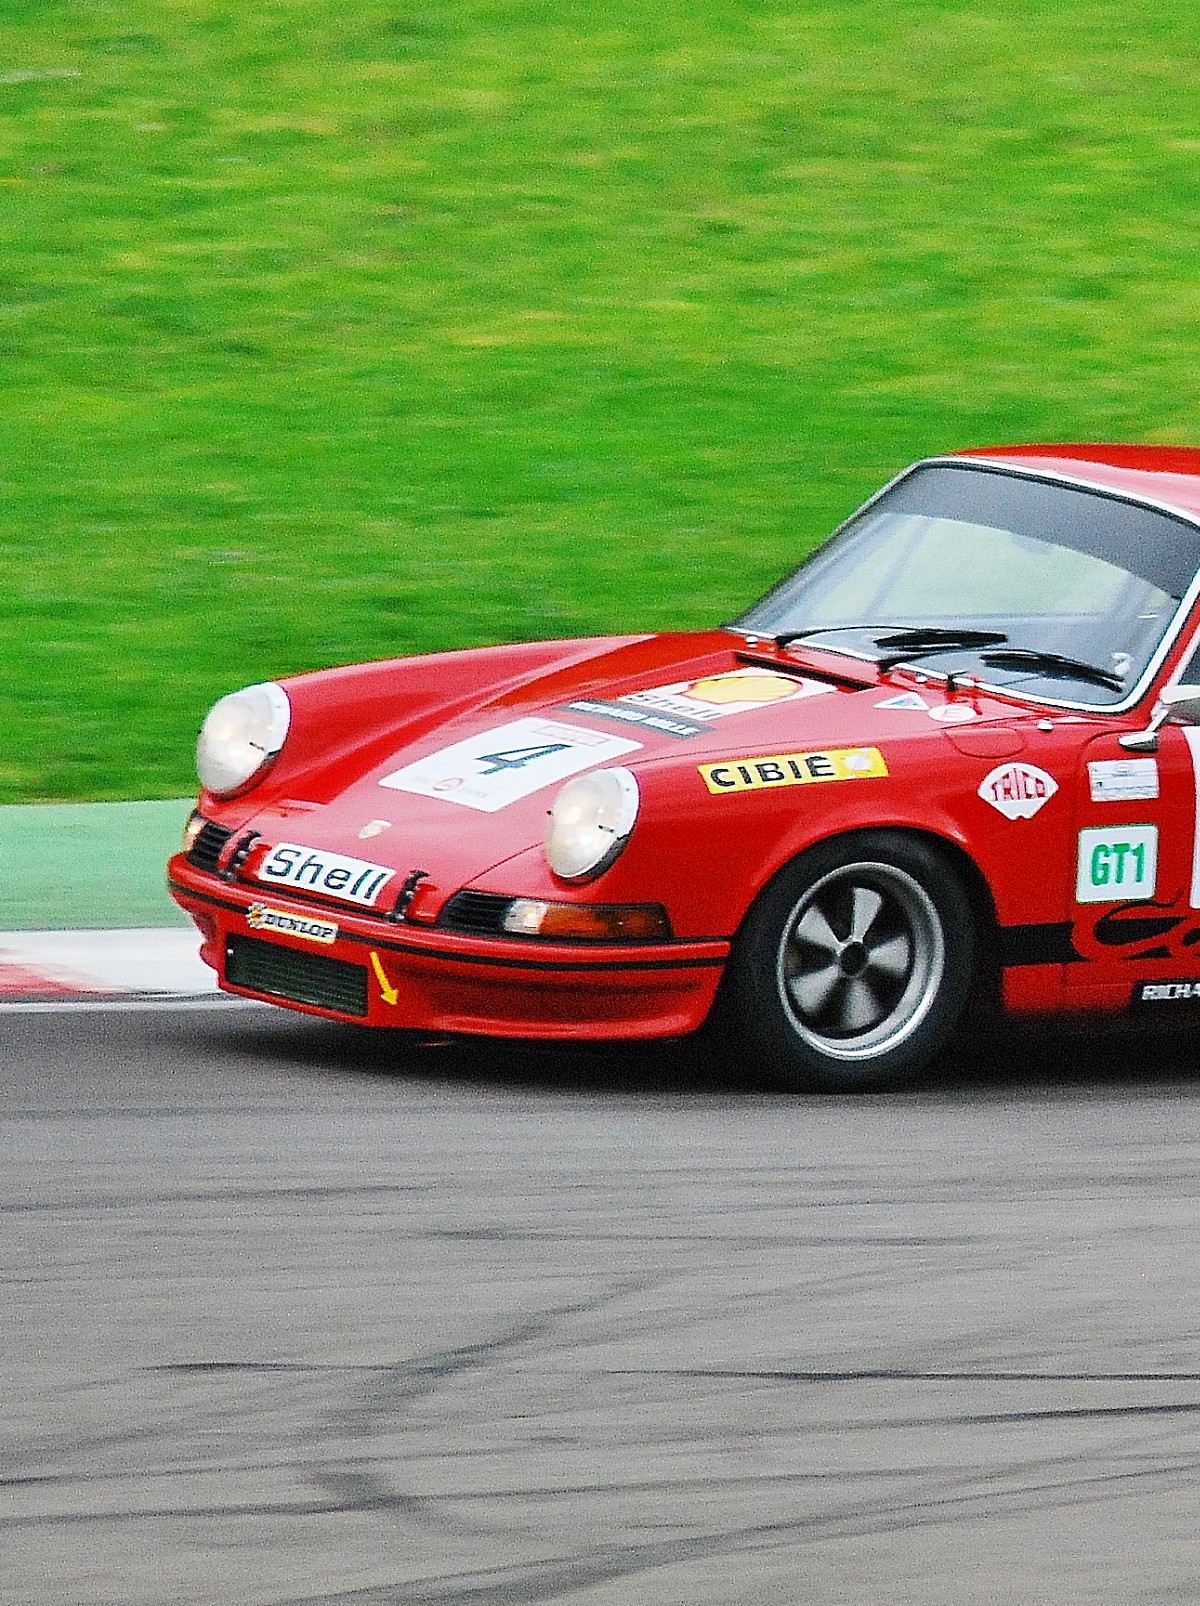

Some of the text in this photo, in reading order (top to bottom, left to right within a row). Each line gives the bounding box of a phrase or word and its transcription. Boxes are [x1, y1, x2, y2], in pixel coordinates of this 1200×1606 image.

[474, 743, 572, 775] 4
[266, 848, 387, 900] Shell
[1091, 843, 1145, 886] GT1
[263, 912, 335, 939] DUNLOP
